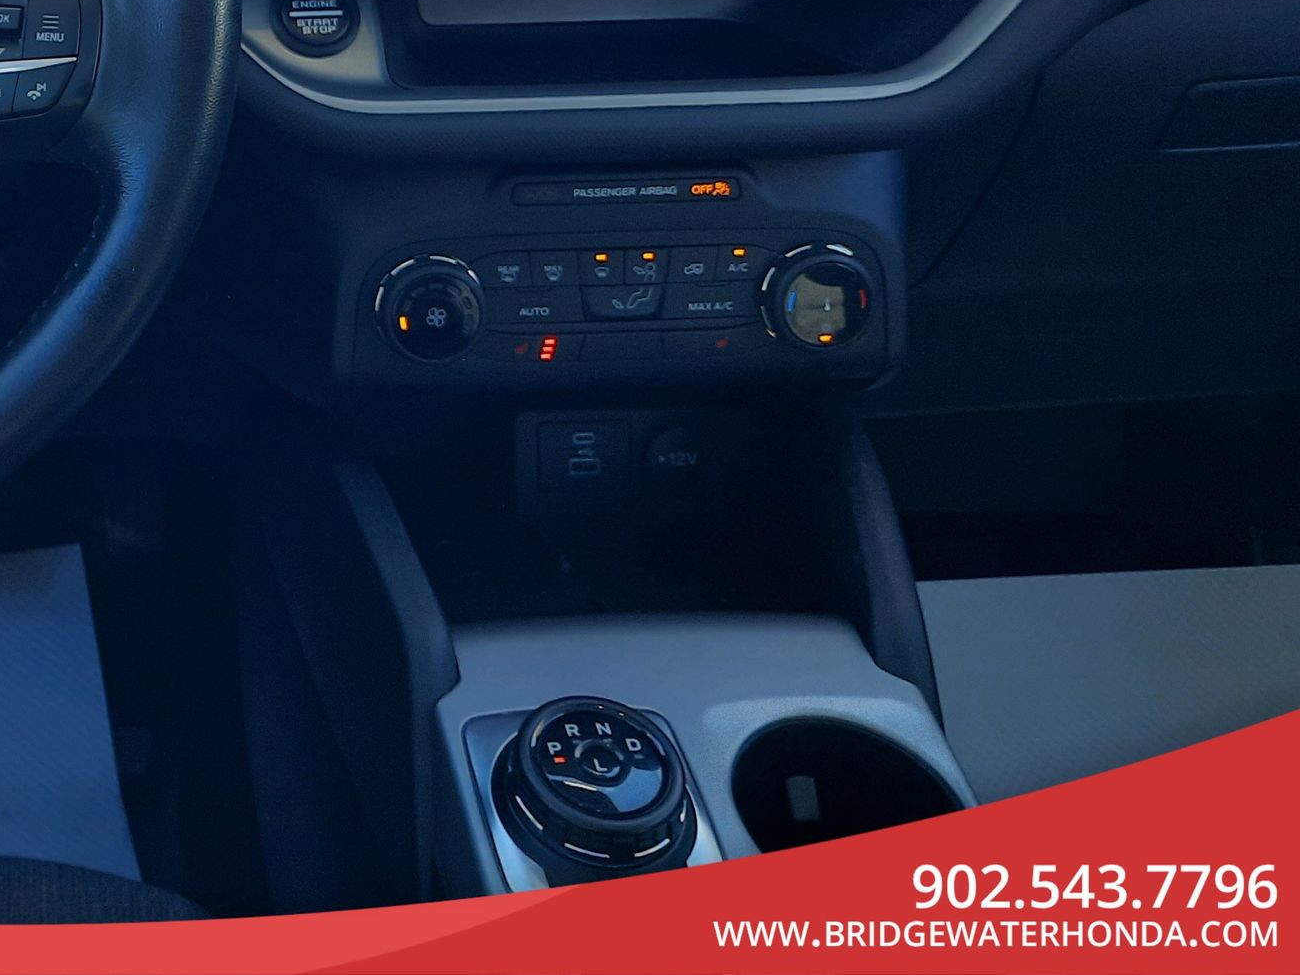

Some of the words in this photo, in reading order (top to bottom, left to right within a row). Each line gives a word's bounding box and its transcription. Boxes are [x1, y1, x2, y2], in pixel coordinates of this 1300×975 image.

[291, 0, 338, 9] ENGINE
[296, 18, 339, 27] START
[302, 25, 337, 35] STOP
[35, 32, 65, 42] MENU
[573, 186, 636, 198] PASSENGER
[638, 185, 678, 196] AIRBAG
[691, 183, 713, 195] OFF
[728, 262, 749, 273] A/C
[519, 306, 550, 316] AUTO
[687, 302, 712, 311] MAX
[713, 301, 734, 311] A/C
[565, 723, 581, 737] R
[595, 722, 612, 735] N
[547, 741, 562, 755] P
[625, 738, 642, 752] D
[593, 758, 607, 772] L
